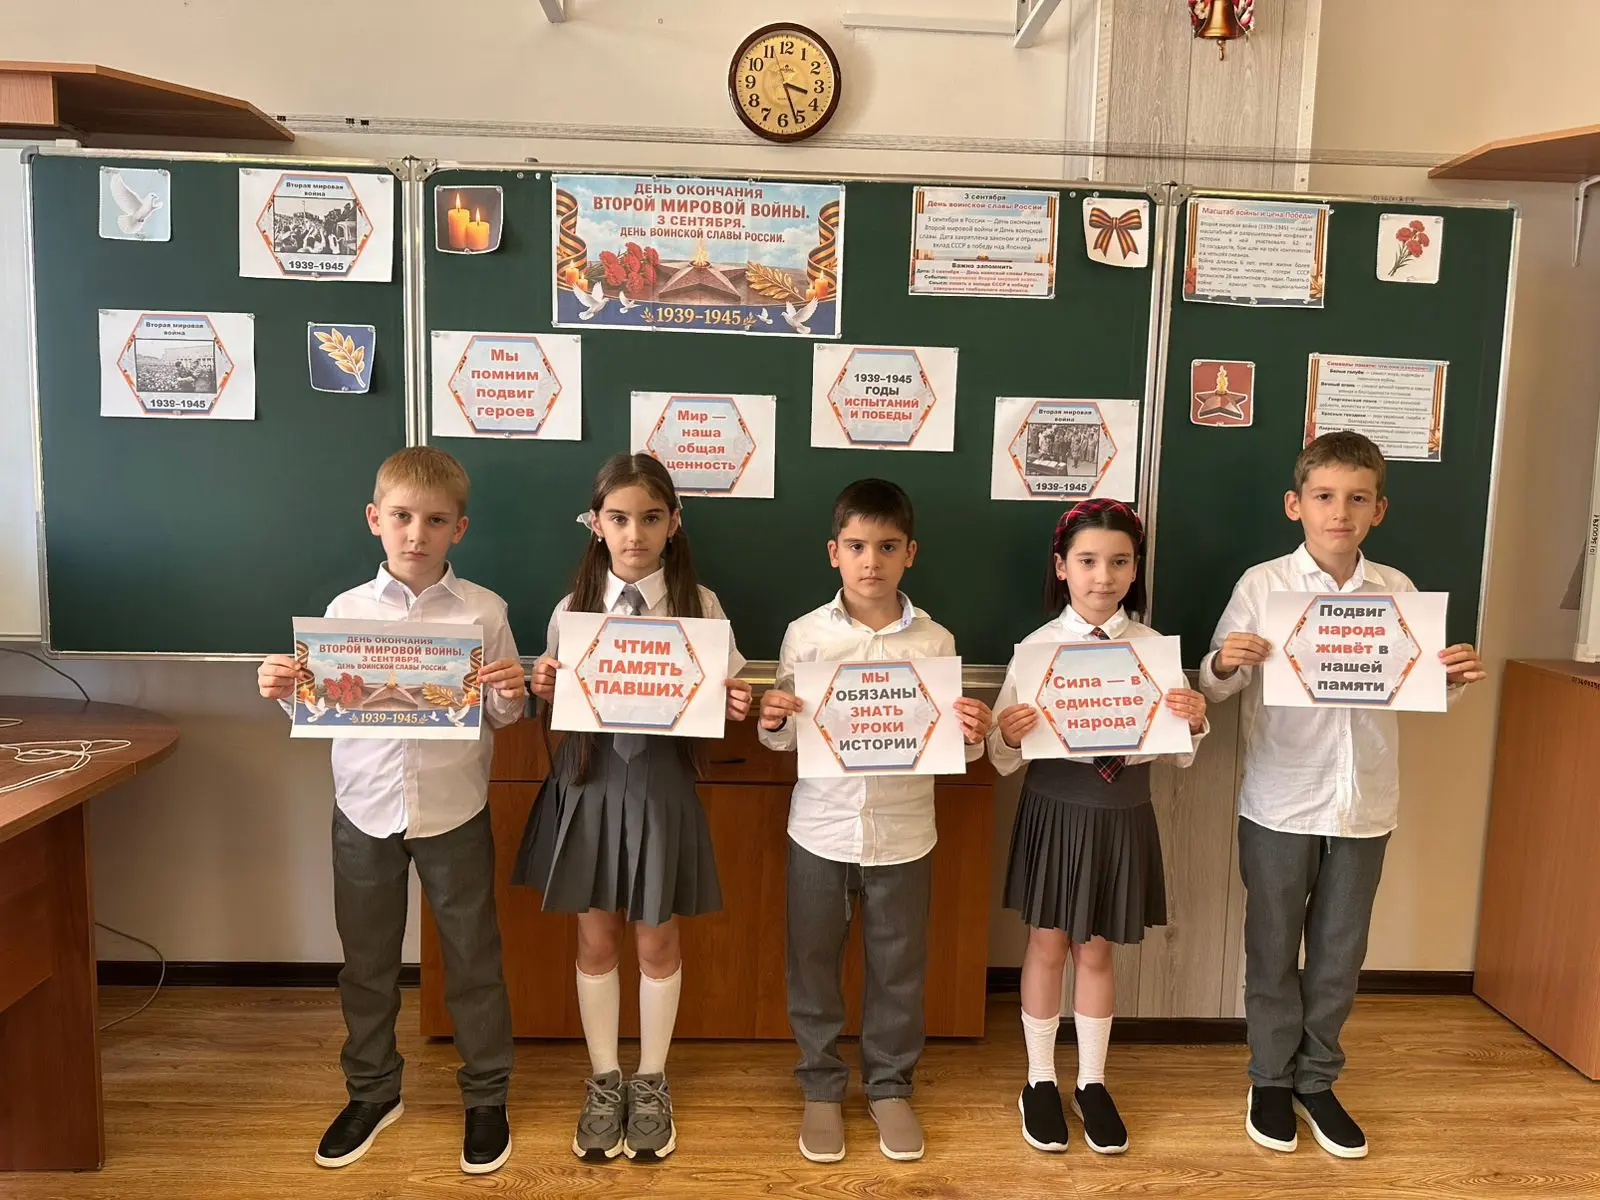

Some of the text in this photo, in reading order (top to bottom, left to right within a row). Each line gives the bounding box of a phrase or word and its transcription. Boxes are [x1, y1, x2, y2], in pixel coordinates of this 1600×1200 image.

[764, 45, 774, 58] 11
[780, 41, 794, 55] 12
[801, 48, 806, 60] 1
[749, 58, 763, 71] 10
[810, 61, 820, 74] 2
[745, 75, 756, 89] 9
[814, 80, 824, 93] 3
[748, 94, 759, 107] 8
[808, 98, 818, 111] 4
[761, 108, 771, 121] 7
[778, 114, 788, 127] 6
[796, 110, 805, 124] 5
[634, 183, 763, 199] ДЕНЬ ОКОНЧАНИЯ
[593, 196, 810, 219] ВТОРОЙ МИРОВОЙ ВОЙНЫ.
[657, 216, 745, 228] 3 СЕНТЯБРЯ.
[620, 227, 784, 243] ДЕНЬ ВОИНСКОЙ СЛАВЫ РОССИИ.
[289, 261, 344, 270] 1939–1945
[656, 308, 740, 325] 1939–1945
[491, 349, 518, 362] Мы
[472, 370, 538, 380] помним
[854, 374, 912, 383] 1939–1945
[476, 388, 534, 400] подвиг
[866, 386, 899, 396] ГОДЫ
[150, 400, 205, 408] 1939–1945
[845, 397, 919, 408] ИСПЫТАНИЙ
[478, 406, 534, 419] героев
[678, 410, 708, 423] Мир
[862, 411, 912, 421] ПОБЕДЫ
[682, 429, 721, 438] наша
[678, 443, 725, 454] общая
[667, 461, 736, 471] ценность
[1036, 483, 1087, 491] 1939–1945
[1320, 605, 1386, 619] Подвиг
[1319, 625, 1385, 638] народа
[320, 643, 464, 656] ВТОРОЙ МИРОВОЙ ВОЙНЫ.
[614, 640, 670, 655] ЧТИМ
[1316, 642, 1388, 654] живёт в
[599, 660, 682, 676] ПАМЯТЬ
[1321, 661, 1382, 673] нашей
[862, 672, 889, 683] МЫ
[1053, 676, 1101, 689] Сила
[1131, 676, 1140, 685] в
[595, 680, 684, 698] ПАВШИХ
[1318, 680, 1384, 692] памяти
[836, 688, 916, 701] ОБЯЗАНЫ
[1056, 696, 1143, 711] единстве
[361, 713, 418, 723] 1939–1945
[851, 705, 903, 718] ЗНАТЬ
[851, 722, 904, 734] УРОКИ
[1068, 716, 1136, 731] народа
[840, 738, 917, 751] ИСТОРИИ
